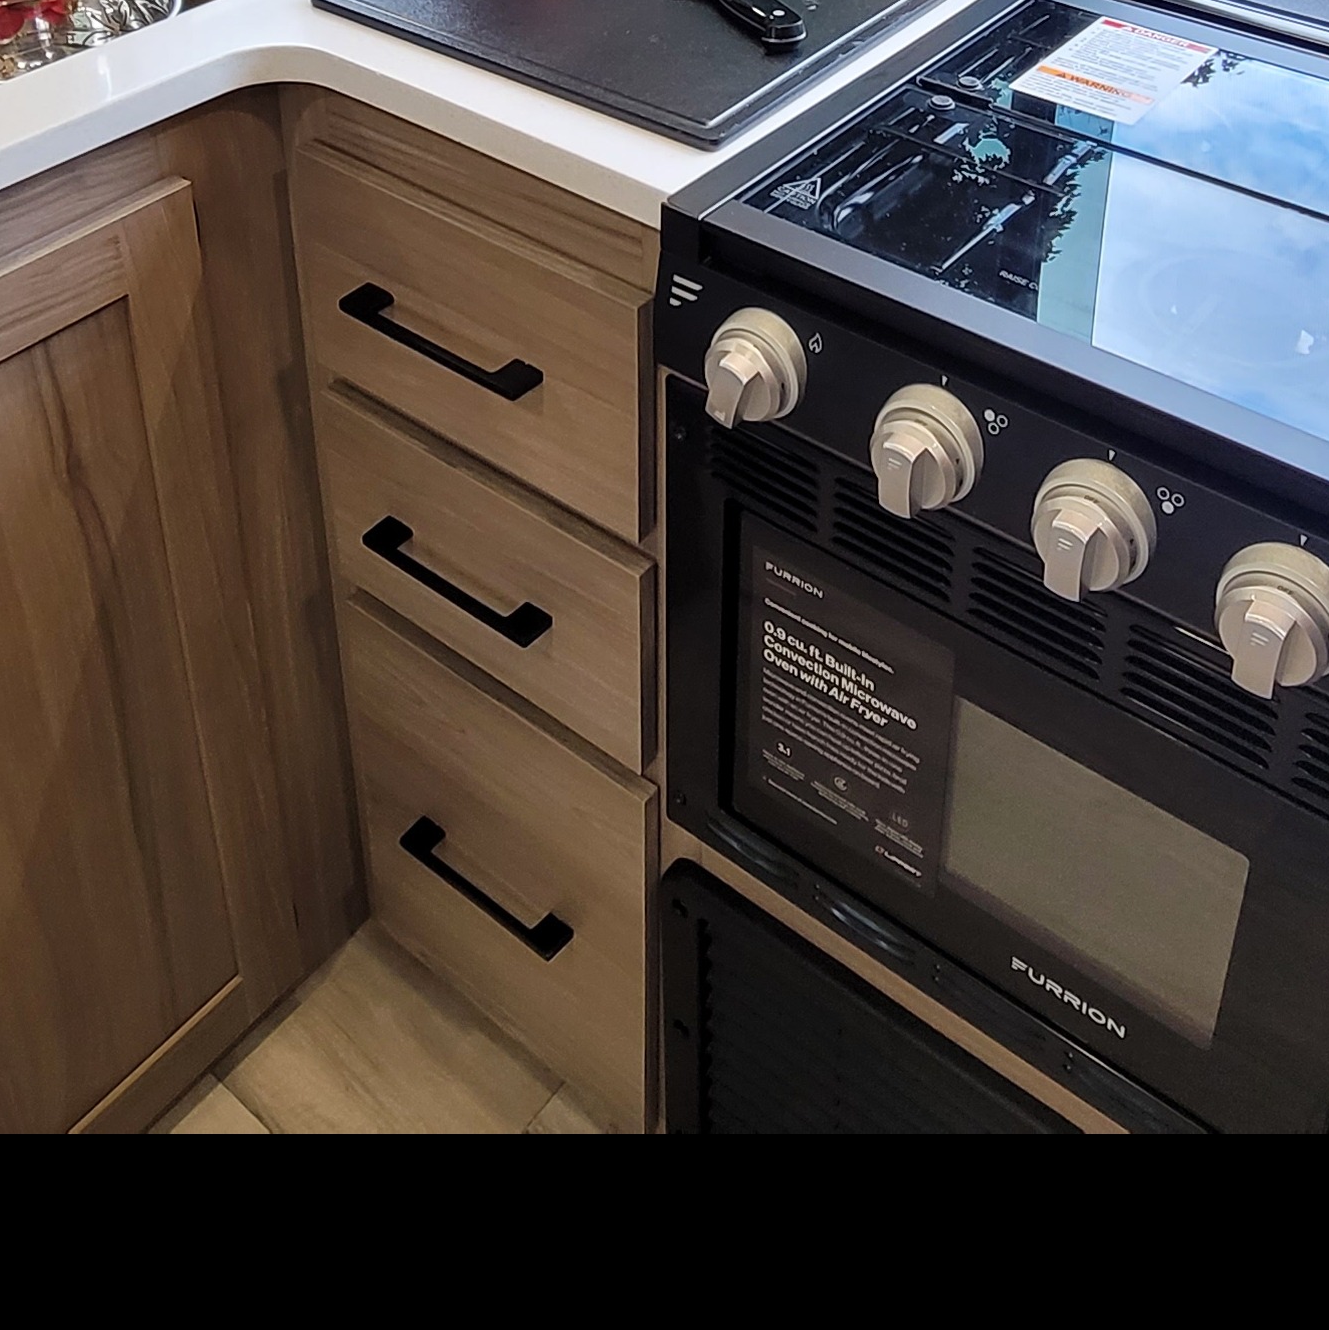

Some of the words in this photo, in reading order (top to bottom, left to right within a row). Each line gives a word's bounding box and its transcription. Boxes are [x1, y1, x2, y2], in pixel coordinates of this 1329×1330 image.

[1133, 28, 1190, 48] DANGER
[1069, 73, 1134, 99] WARNING
[999, 270, 1030, 287] RAISE
[765, 561, 824, 599] FURRION
[763, 620, 787, 641] 0.9
[786, 634, 808, 654] cu.
[809, 644, 824, 663] ft.
[763, 634, 840, 686] Convection
[841, 677, 918, 730] Microwave
[763, 648, 799, 677] Oven
[799, 668, 829, 694] with
[828, 686, 850, 705] Air
[850, 697, 889, 727] Fryer
[1011, 956, 1126, 1039] FURRION
